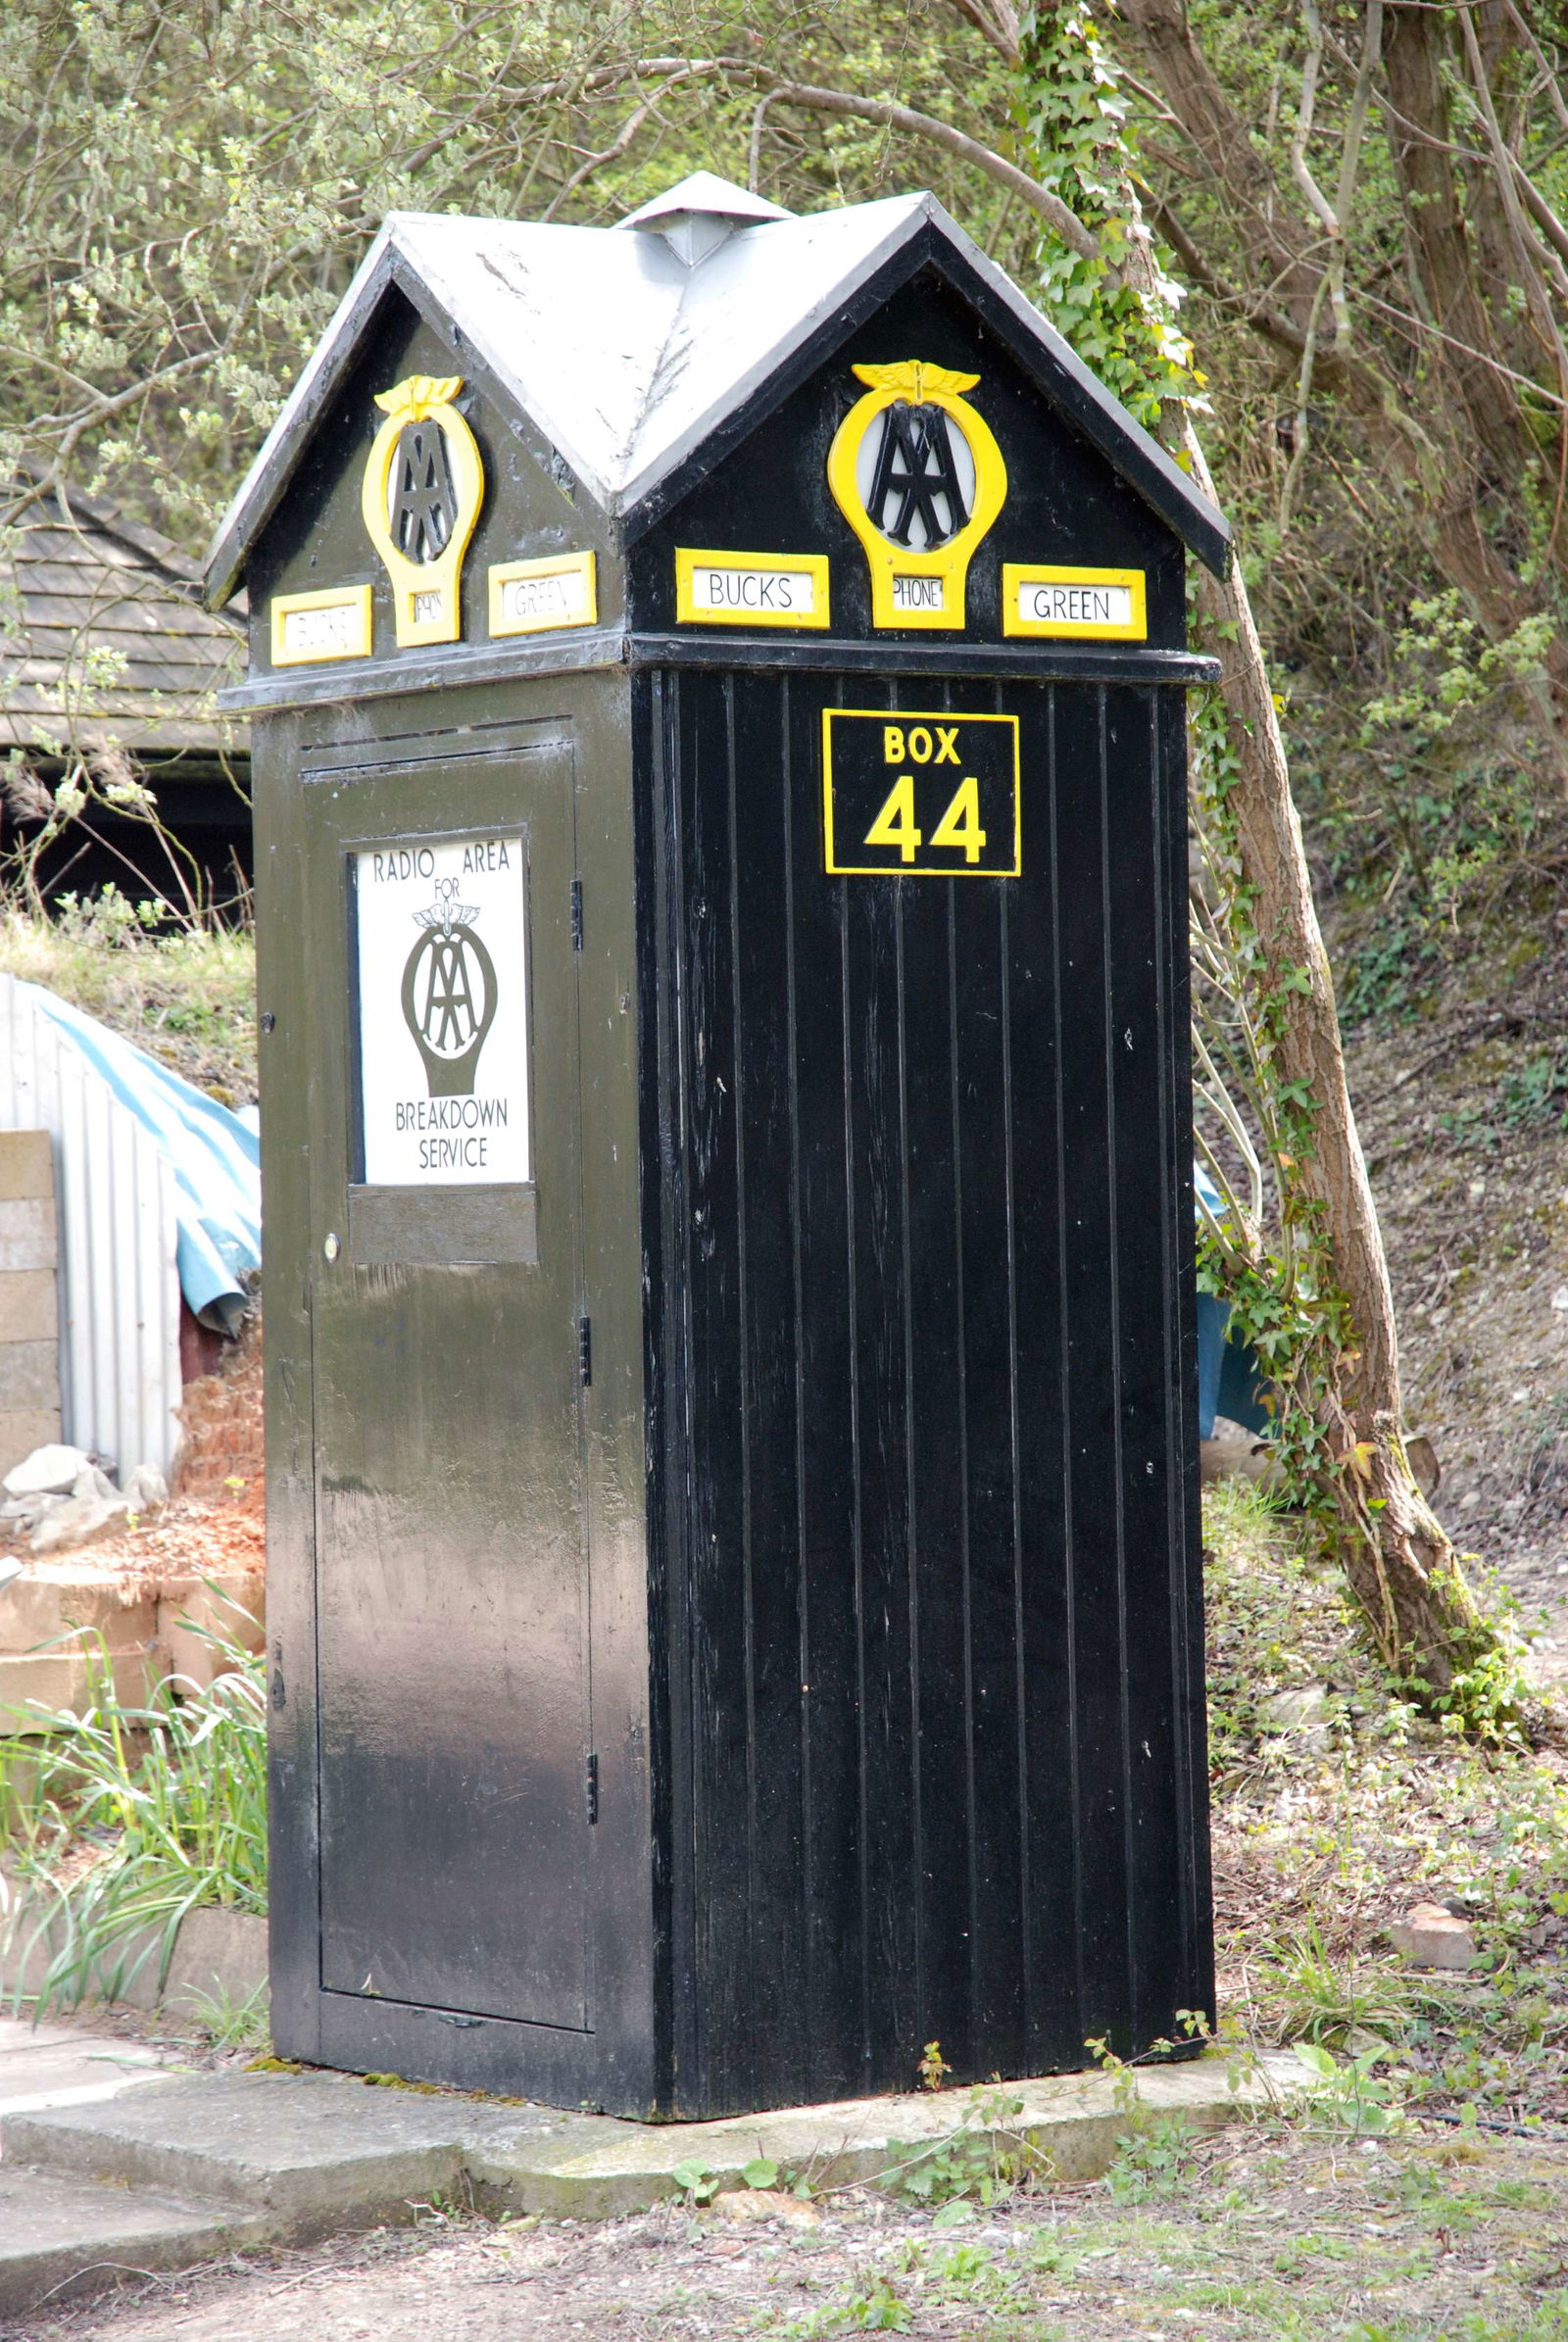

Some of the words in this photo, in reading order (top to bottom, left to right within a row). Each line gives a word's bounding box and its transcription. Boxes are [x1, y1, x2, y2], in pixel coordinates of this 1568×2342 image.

[389, 417, 457, 566] AA
[866, 403, 972, 550] AA
[710, 573, 793, 609] BUCKS
[893, 578, 939, 607] PHONE
[1034, 589, 1109, 620] GREEN
[884, 726, 961, 764] BOX
[863, 775, 986, 863] 44
[373, 848, 435, 883] RADIO
[463, 840, 510, 874] AREA
[435, 877, 460, 900] FOR
[423, 941, 479, 1051] AA
[396, 1098, 508, 1132] BREAKDOWN
[418, 1137, 488, 1169] SERVICE
